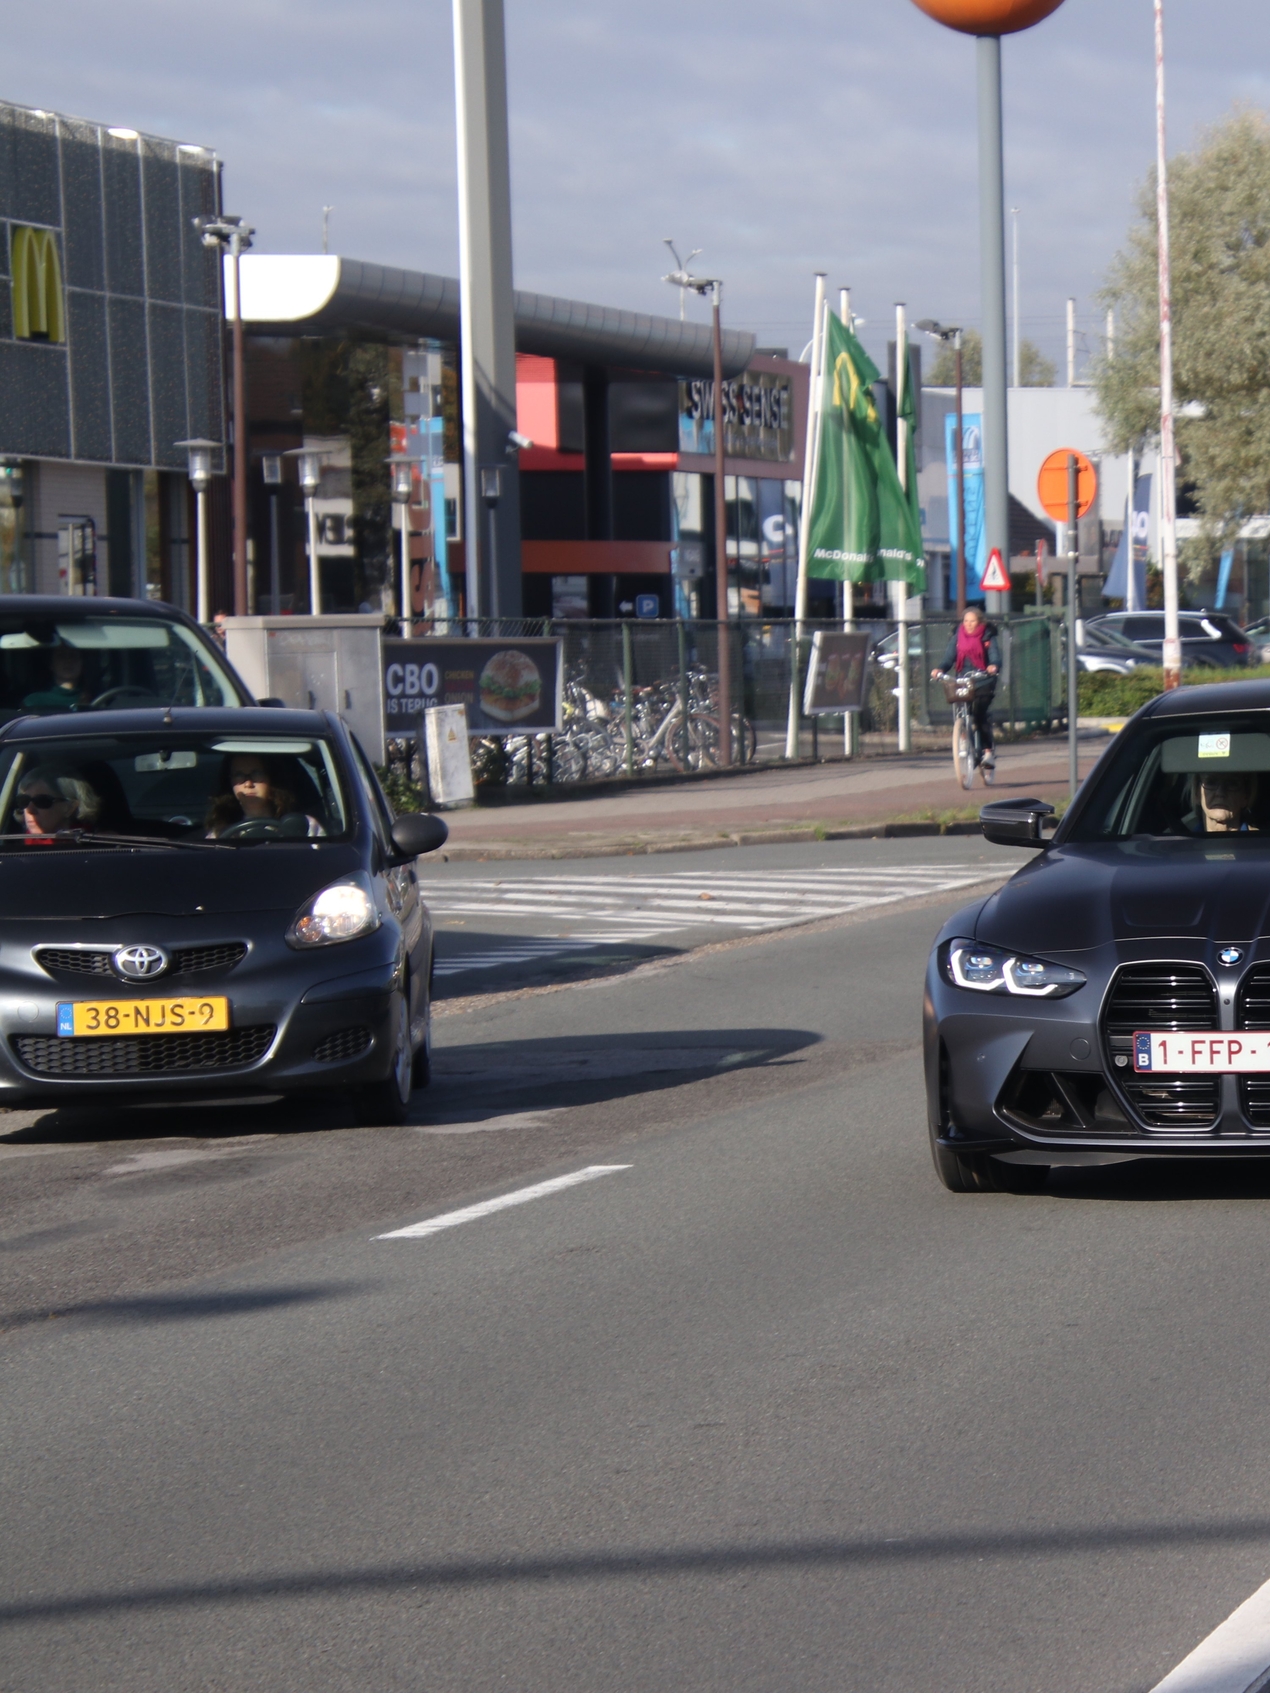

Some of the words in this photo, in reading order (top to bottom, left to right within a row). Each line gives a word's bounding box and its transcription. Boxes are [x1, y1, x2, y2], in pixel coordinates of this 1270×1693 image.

[688, 380, 738, 423] SWSS
[741, 384, 788, 429] SENSE
[642, 600, 654, 613] P
[386, 662, 439, 696] CBO
[387, 698, 398, 714] IS
[85, 1002, 214, 1030] 38-NJS-9
[60, 1023, 72, 1031] NL
[1138, 1053, 1149, 1066] B
